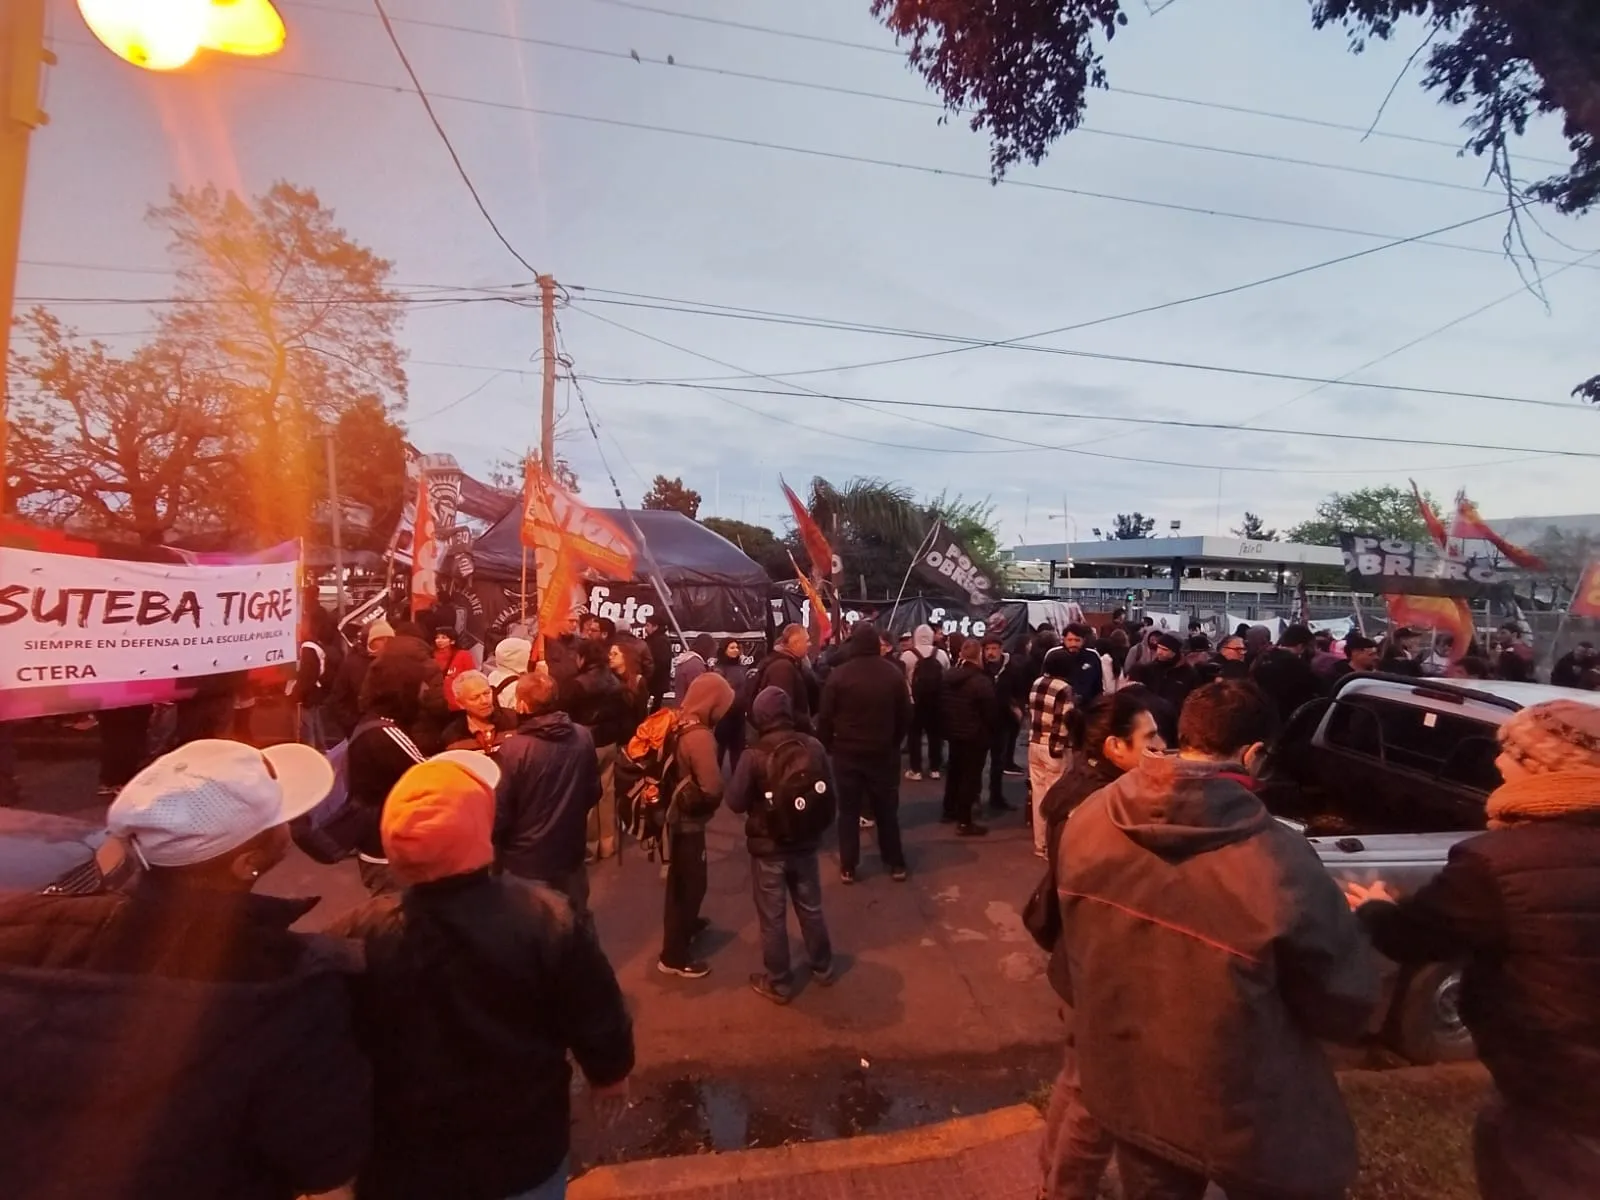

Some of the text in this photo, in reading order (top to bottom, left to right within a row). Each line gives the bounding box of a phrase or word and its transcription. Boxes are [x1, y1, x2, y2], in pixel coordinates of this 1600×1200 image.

[945, 543, 990, 590] POLO
[0, 584, 292, 628] SUTEBA TIGRE
[589, 586, 654, 625] fate
[928, 607, 986, 637] fate
[24, 640, 93, 650] SIEMPRE
[97, 639, 116, 648] EN
[121, 638, 180, 648] DEFENSA
[183, 637, 198, 646] DE
[201, 636, 213, 645] LA
[216, 633, 253, 644] ESCUELA
[265, 649, 284, 662] CTA
[16, 664, 97, 681] CTERA
